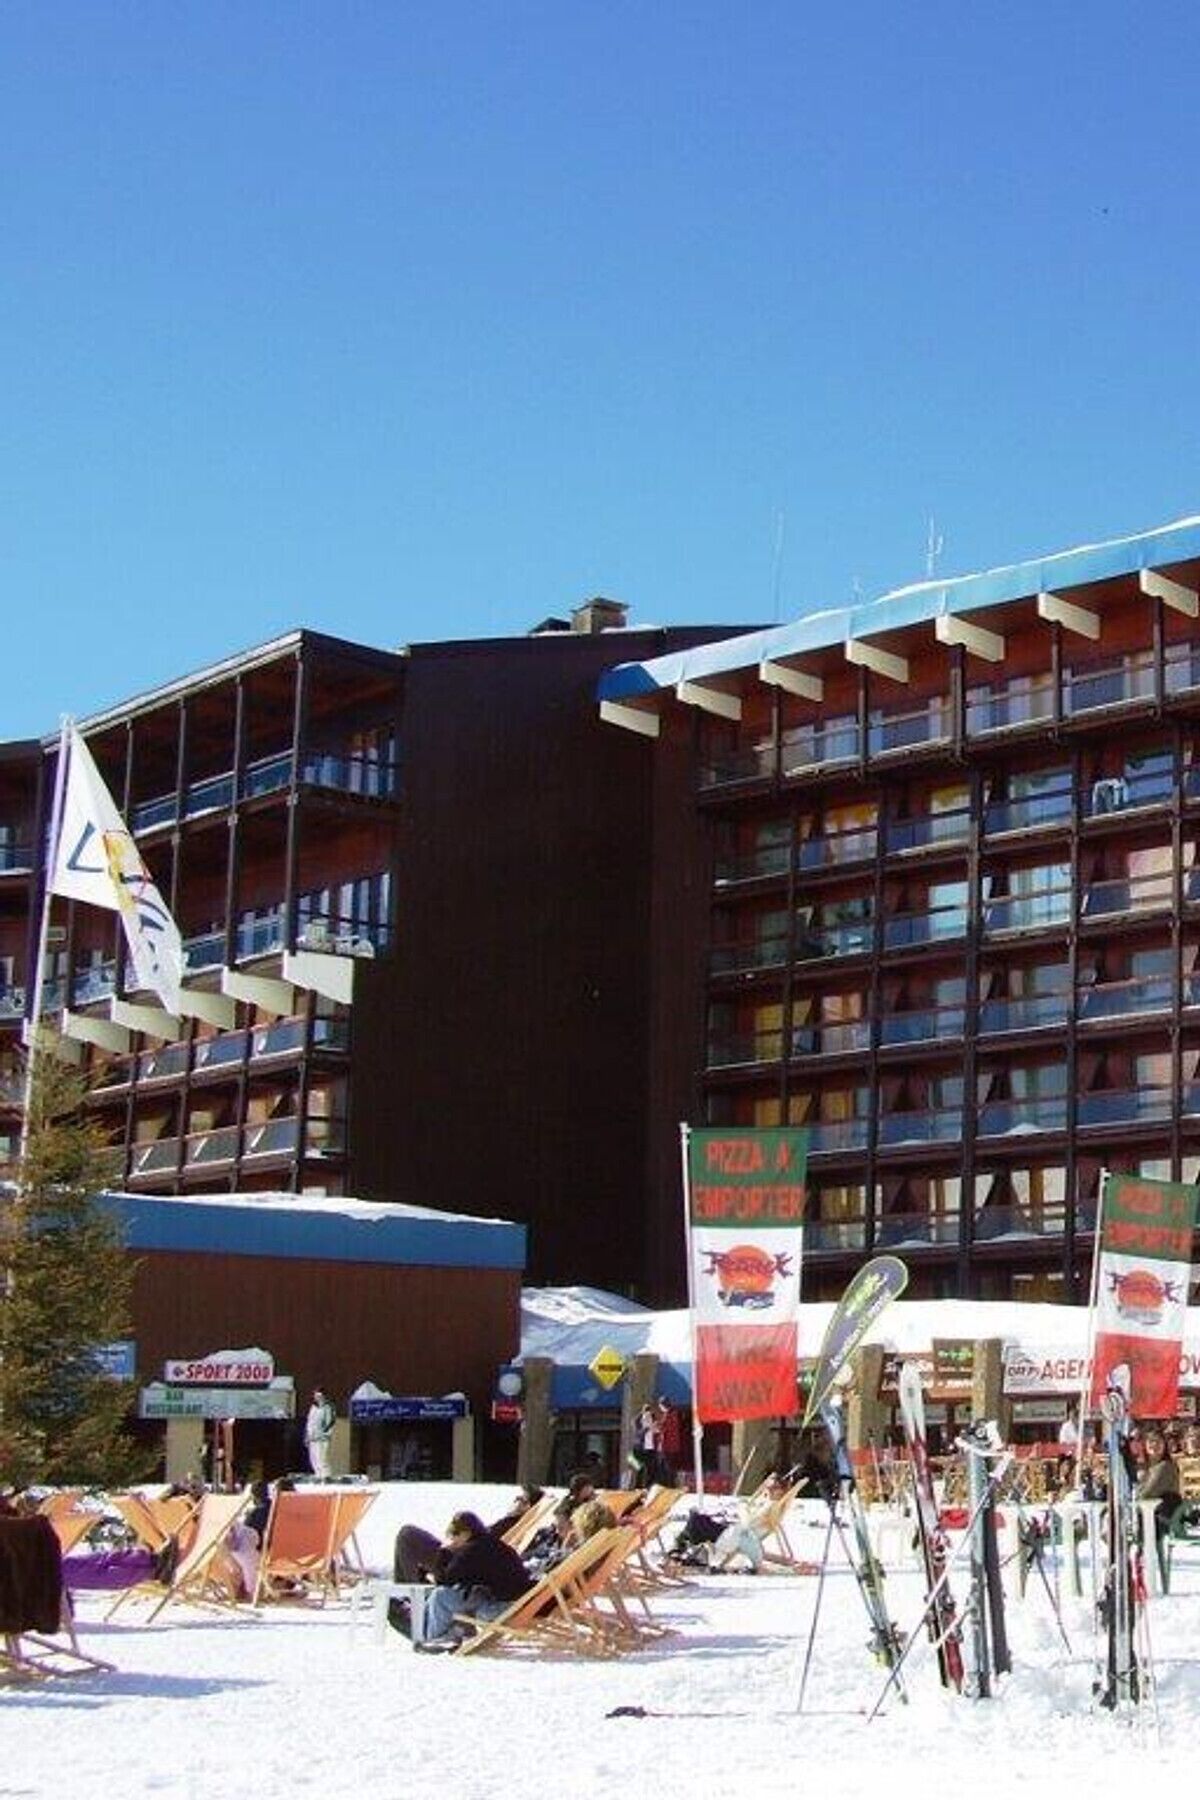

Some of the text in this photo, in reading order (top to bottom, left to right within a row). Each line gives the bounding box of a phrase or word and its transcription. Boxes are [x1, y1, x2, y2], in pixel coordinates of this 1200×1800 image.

[705, 1140, 764, 1173] PIZZA
[693, 1185, 805, 1219] EMPORTER
[186, 1363, 271, 1379] SPORT 2000
